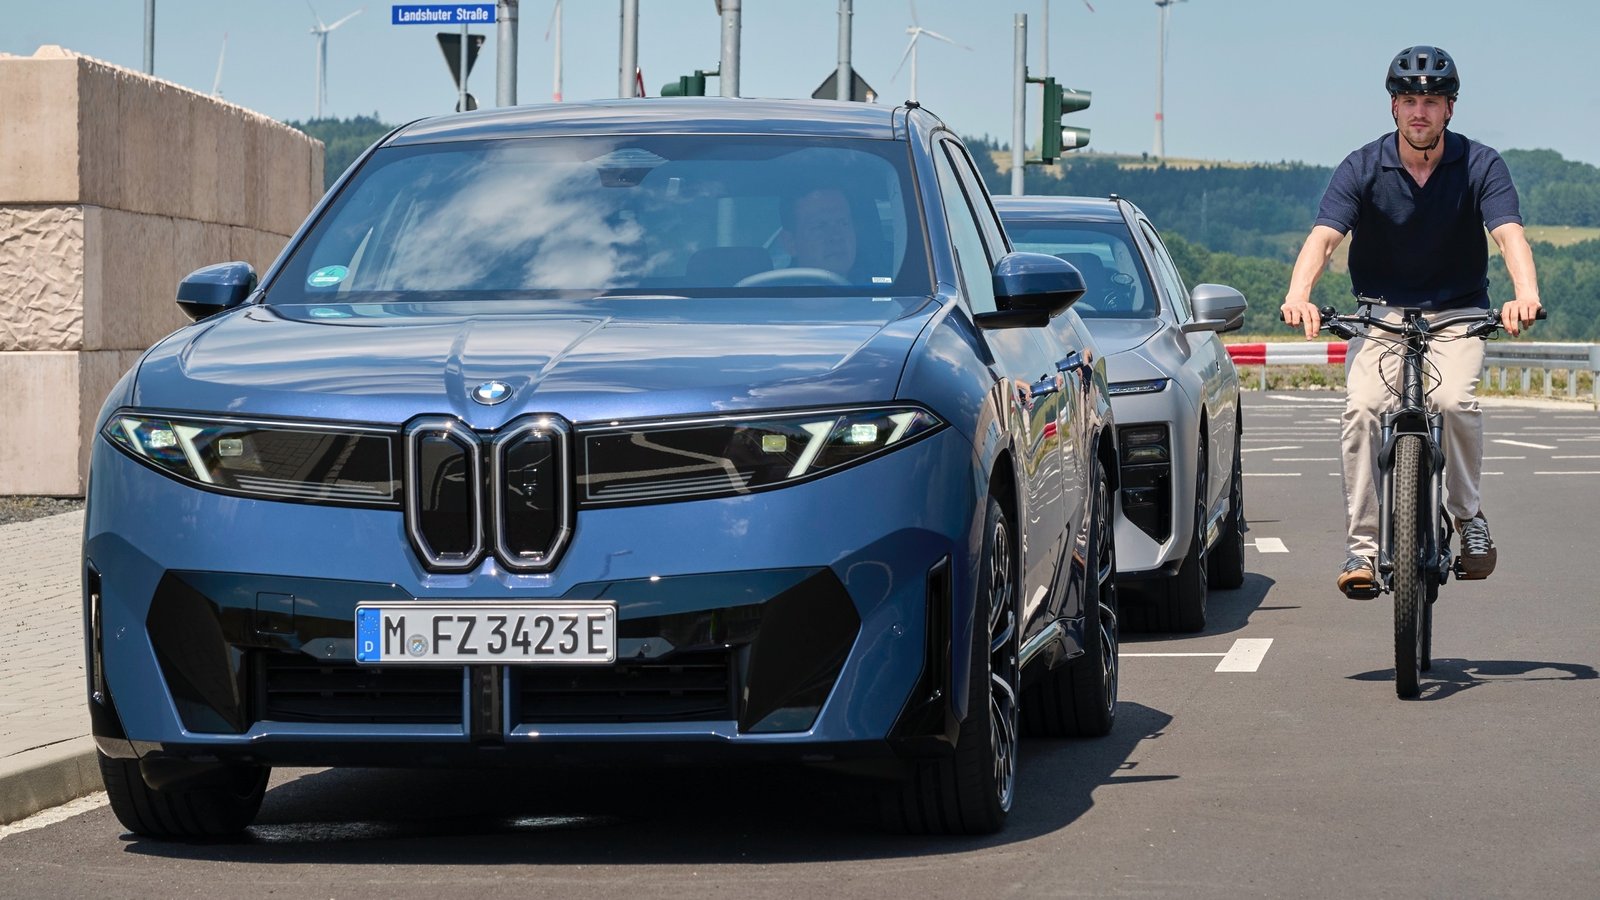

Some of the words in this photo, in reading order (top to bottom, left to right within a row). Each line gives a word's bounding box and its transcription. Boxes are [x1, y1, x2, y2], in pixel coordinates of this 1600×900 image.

[398, 8, 452, 21] Landshuter
[456, 7, 489, 20] Straße
[384, 615, 406, 655] M
[432, 615, 478, 655] FZ
[364, 640, 374, 653] D
